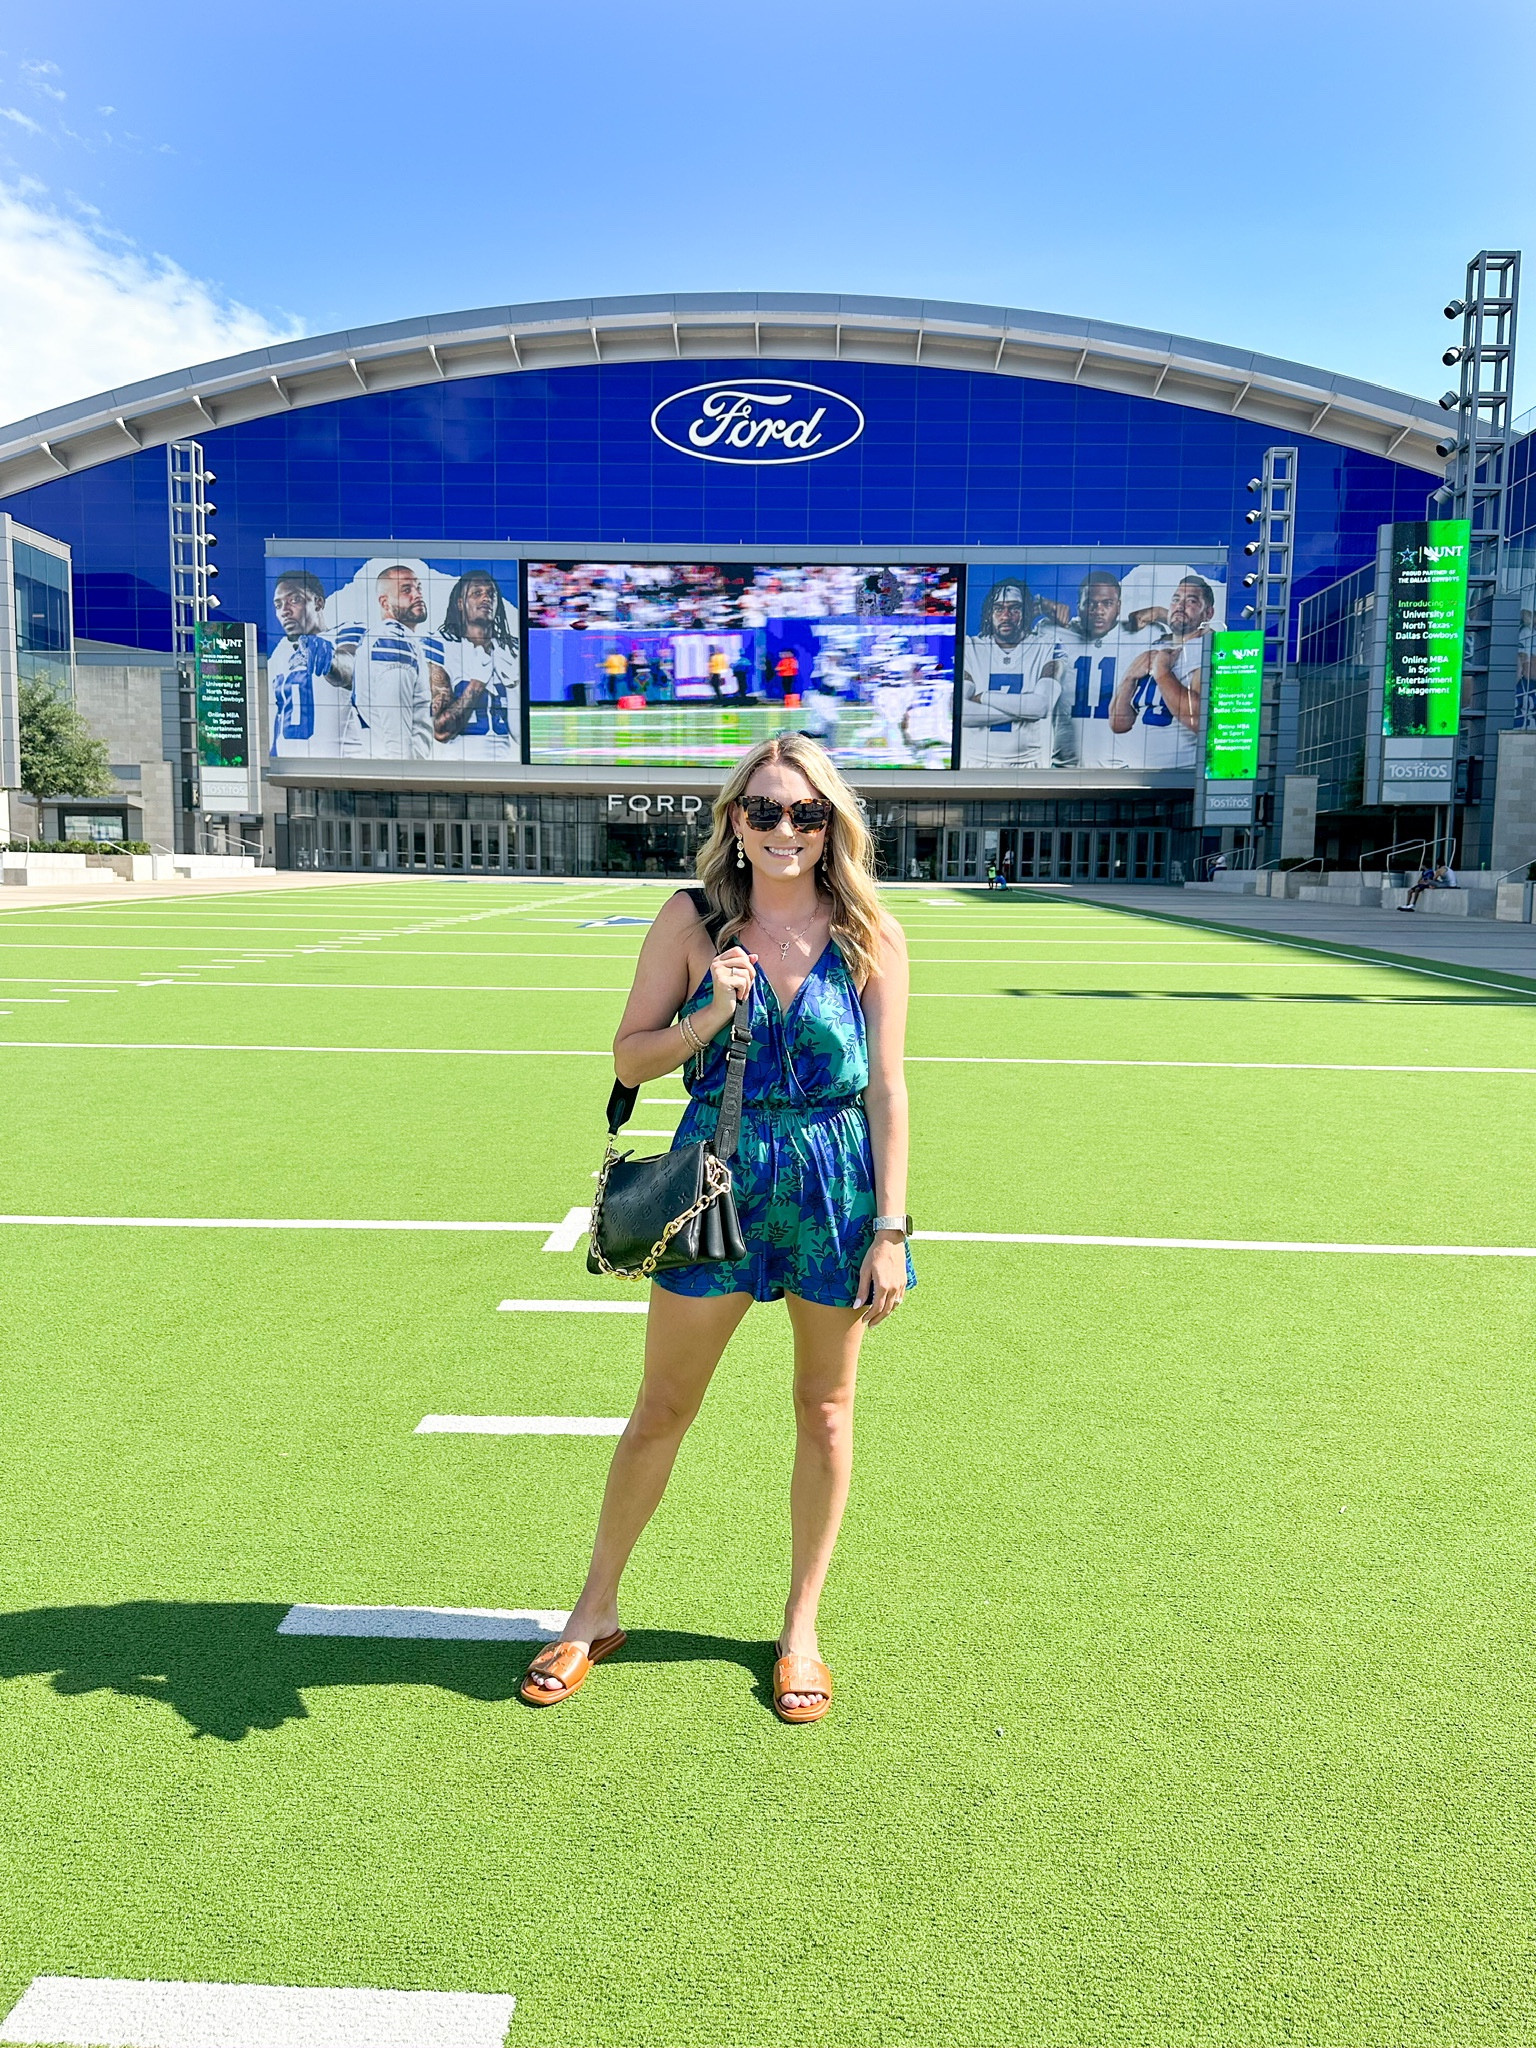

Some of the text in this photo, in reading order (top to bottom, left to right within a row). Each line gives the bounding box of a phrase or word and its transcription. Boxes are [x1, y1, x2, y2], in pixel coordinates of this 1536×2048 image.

[688, 390, 827, 449] Ford
[1435, 546, 1464, 557] UNT
[1398, 599, 1444, 608] Introducing
[1402, 610, 1444, 619] University
[1402, 622, 1426, 630] North
[1395, 631, 1459, 640] Dallas Cowboys
[224, 639, 243, 648] UNT
[1401, 656, 1428, 664] Online
[1418, 665, 1441, 674] Sport
[1395, 676, 1453, 684] Entertainment
[1071, 656, 1116, 719] 11
[1397, 687, 1450, 695] Management
[607, 794, 703, 812] FORD
